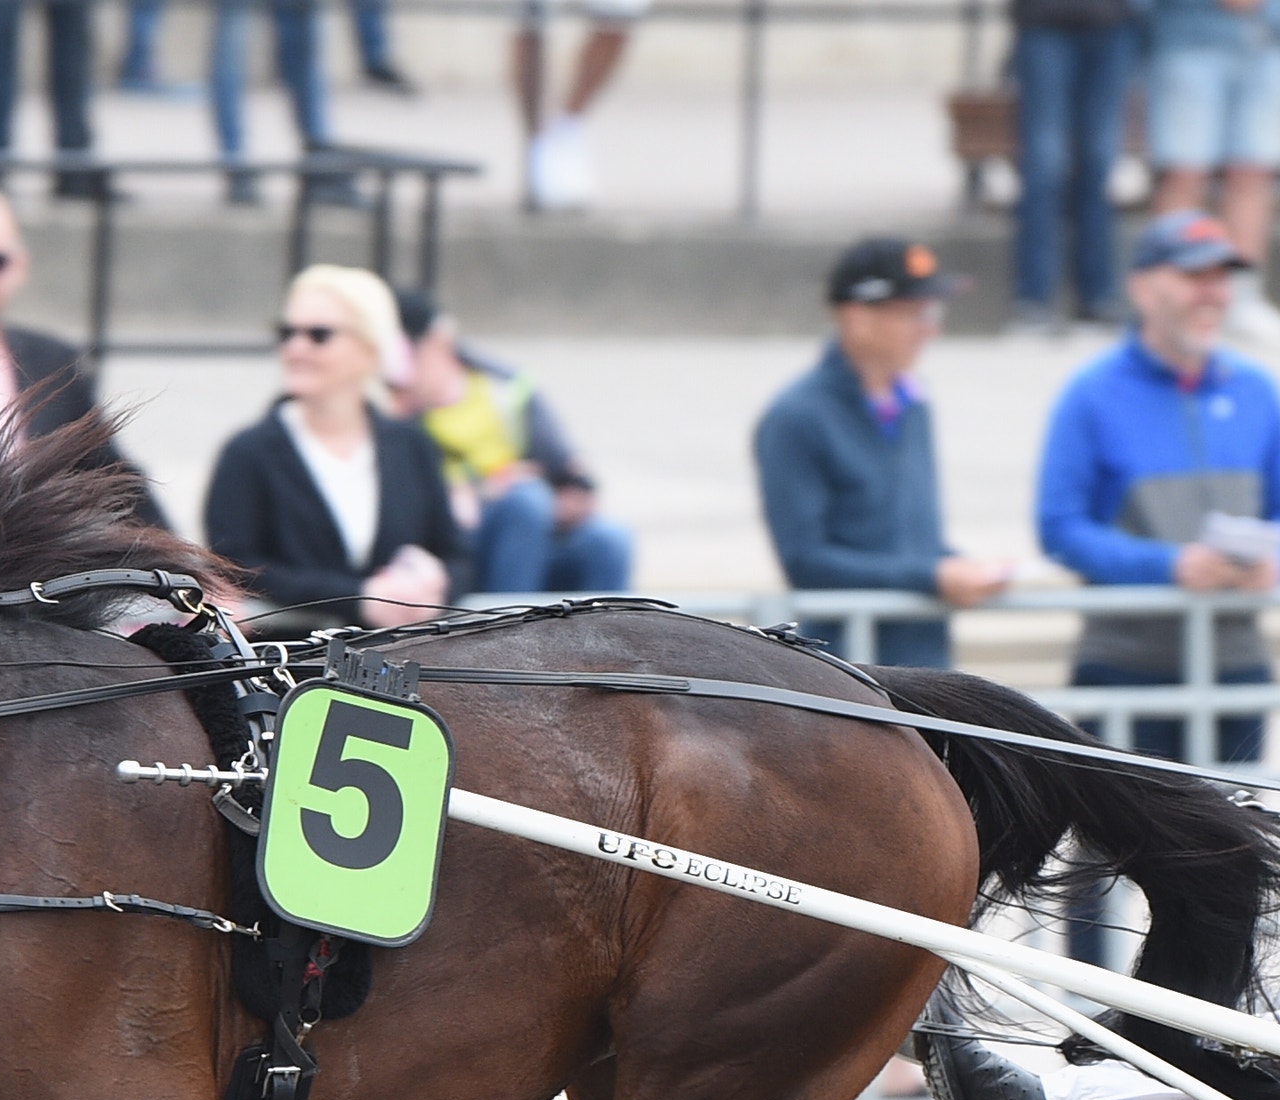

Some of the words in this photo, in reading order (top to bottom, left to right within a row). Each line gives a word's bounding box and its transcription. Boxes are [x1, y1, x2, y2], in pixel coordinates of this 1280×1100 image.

[300, 698, 414, 870] 5
[597, 831, 678, 869] UFO
[683, 857, 803, 905] ECLIPSE
